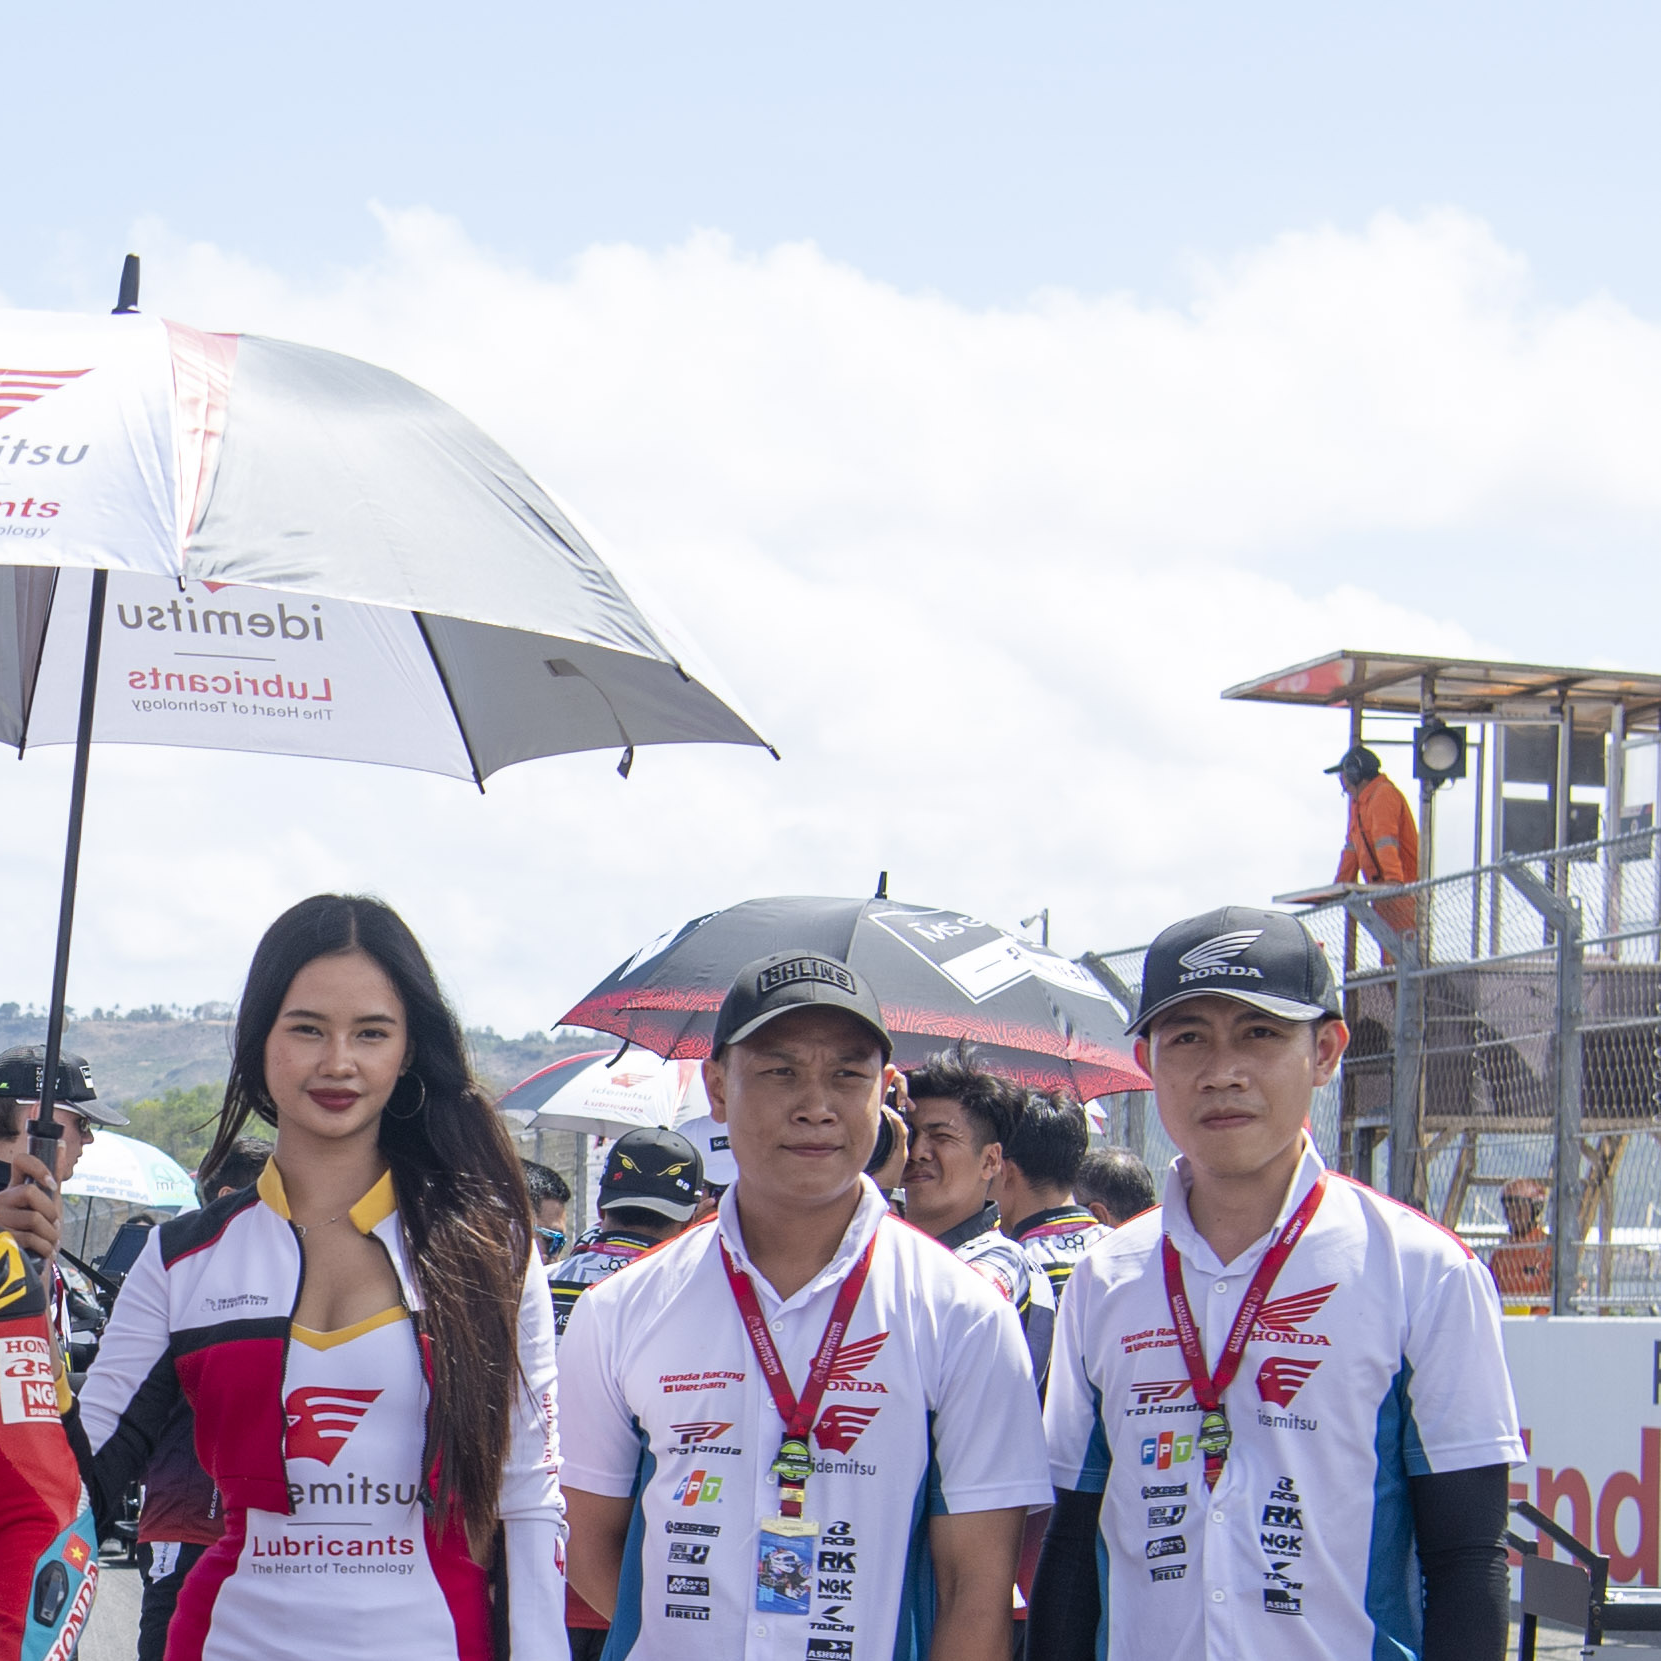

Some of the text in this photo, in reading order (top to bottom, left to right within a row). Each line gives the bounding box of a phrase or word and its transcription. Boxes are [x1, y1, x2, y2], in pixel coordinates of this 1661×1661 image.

[1178, 966, 1264, 983] HONDA
[1250, 1330, 1332, 1346] HONDA
[659, 1371, 746, 1384] Honda Racing
[674, 1380, 727, 1392] Vietnam
[825, 1380, 889, 1393] ONDA
[1142, 1438, 1191, 1463] FPT
[810, 1458, 876, 1476] idemitsu
[288, 1472, 416, 1505] emitsu
[1269, 1490, 1300, 1503] RCB
[1262, 1505, 1303, 1526] RK
[252, 1535, 414, 1557] Lubricants
[821, 1536, 856, 1546] RCB
[1261, 1532, 1303, 1551] NGK
[251, 1562, 415, 1575] The Heart of Technology
[817, 1551, 857, 1571] RK
[818, 1579, 852, 1594] NGK
[665, 1604, 710, 1620] PIRELLI
[809, 1622, 855, 1632] TAICHI
[808, 1650, 851, 1661] ASHUKA
